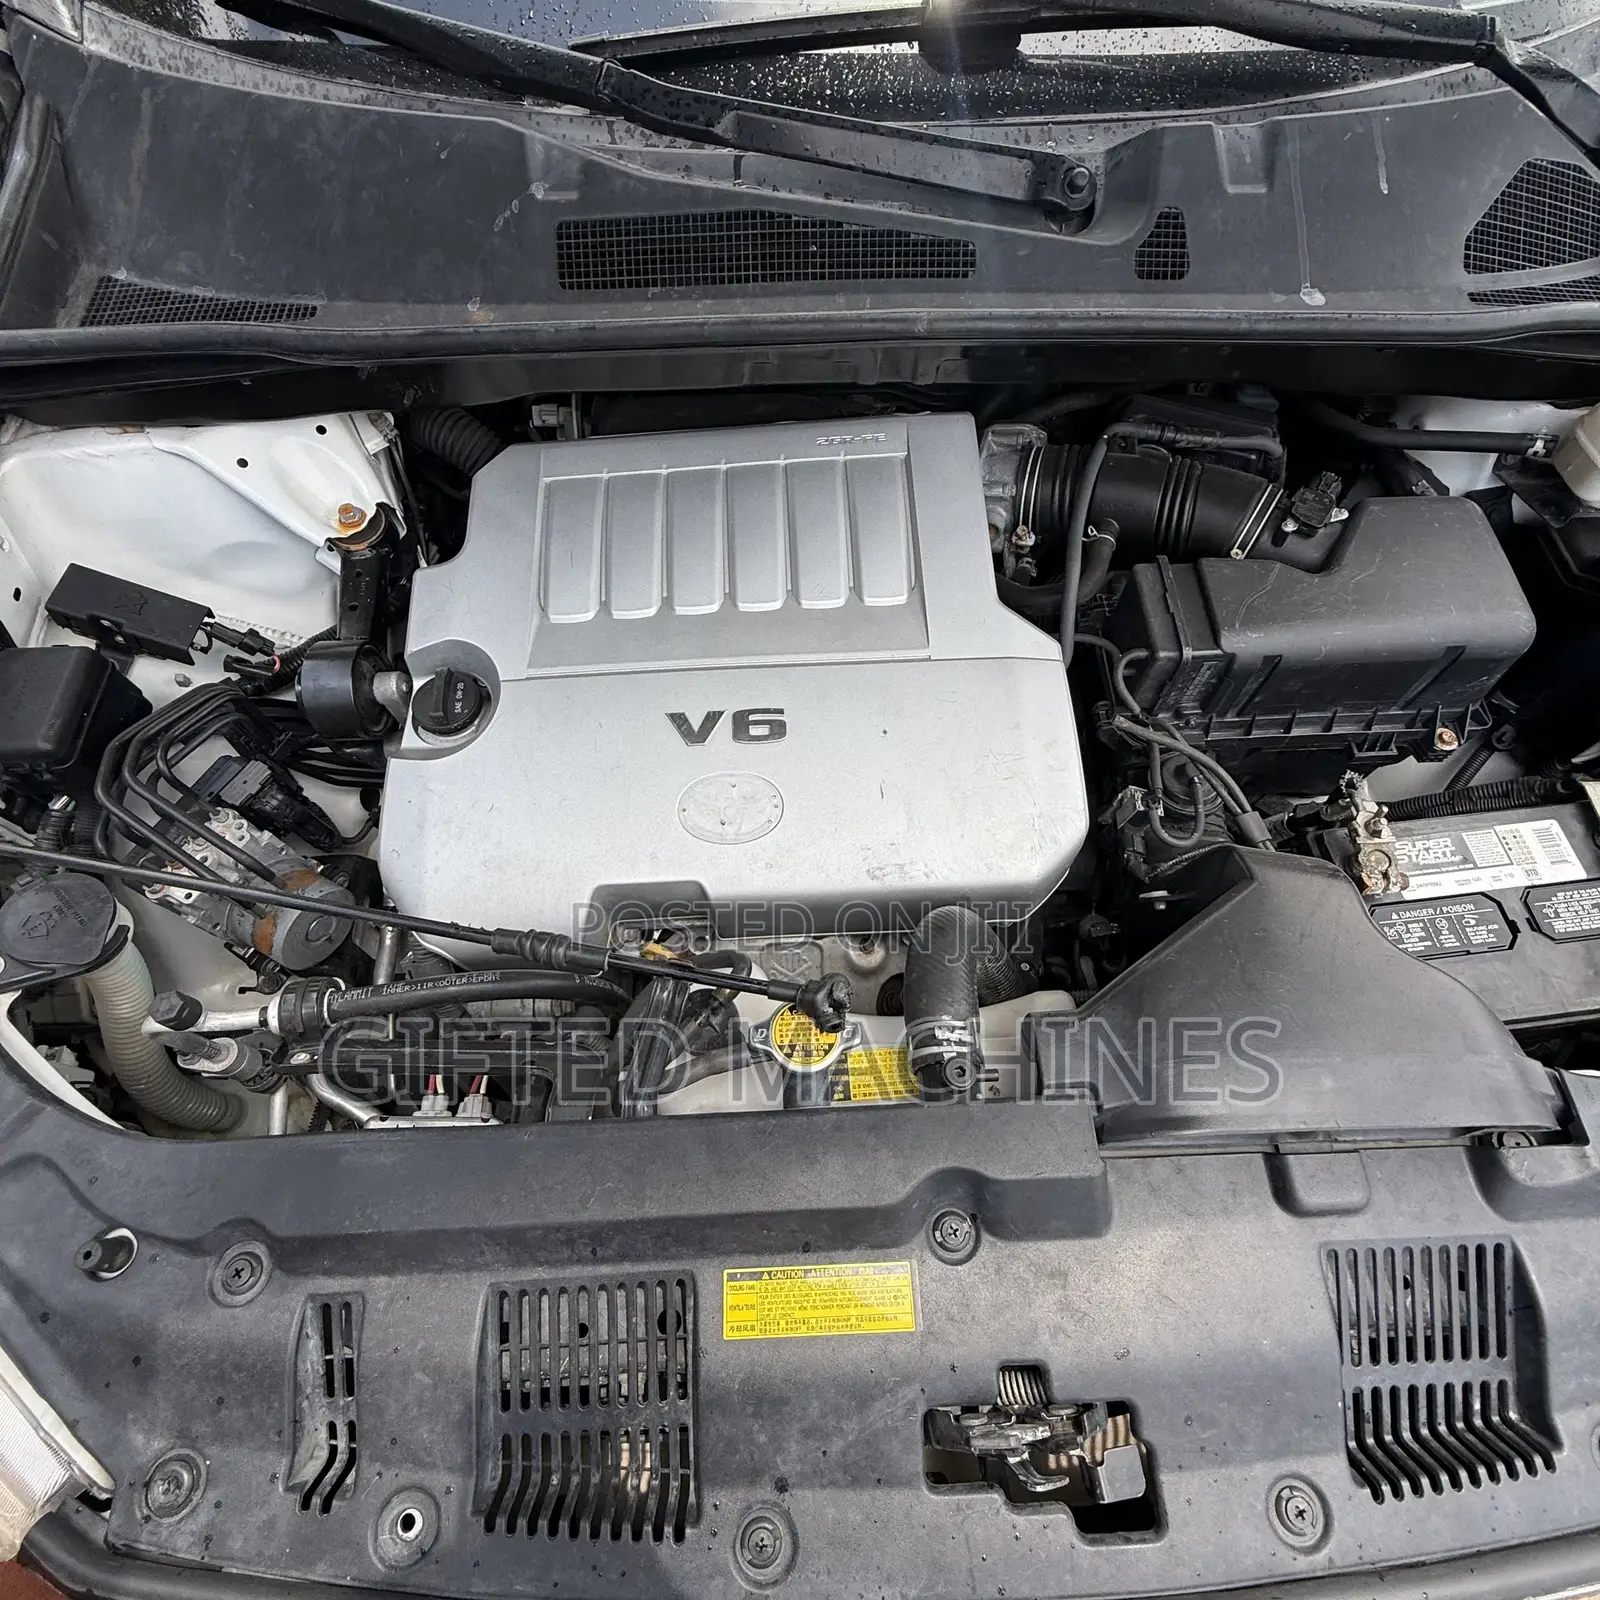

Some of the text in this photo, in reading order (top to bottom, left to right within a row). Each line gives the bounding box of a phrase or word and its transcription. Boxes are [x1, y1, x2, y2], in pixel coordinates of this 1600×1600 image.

[454, 701, 463, 713] SAE
[664, 707, 787, 747] V6
[1394, 837, 1453, 851] SUPER
[1393, 846, 1456, 864] START
[1399, 908, 1435, 919] DANGER
[1442, 903, 1475, 914] POISON
[795, 1043, 829, 1051] ATTENTION
[771, 1267, 852, 1279] CAUTION ATTENTION
